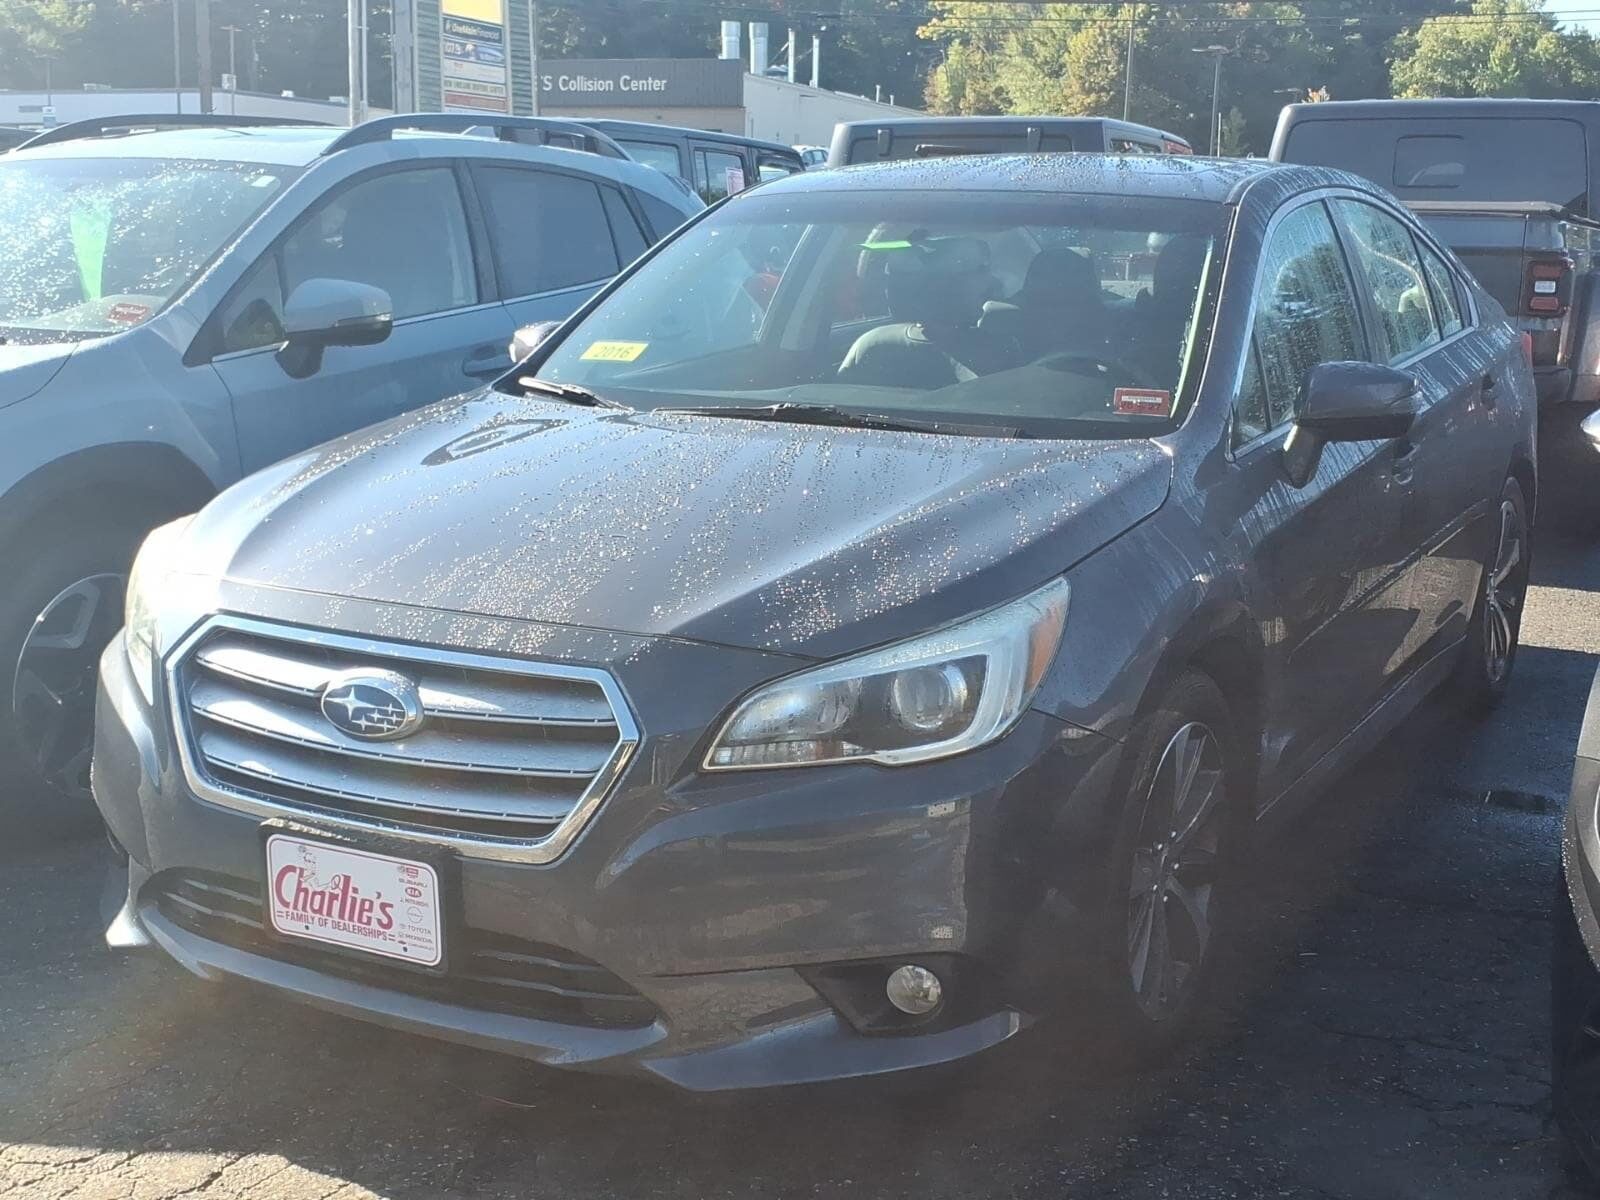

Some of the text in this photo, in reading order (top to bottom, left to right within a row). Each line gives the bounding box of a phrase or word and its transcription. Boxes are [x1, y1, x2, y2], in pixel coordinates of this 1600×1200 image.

[558, 75, 614, 92] Collision
[620, 75, 667, 91] Center
[592, 346, 635, 358] 2016
[275, 864, 394, 930] Charlie's
[285, 911, 388, 942] FAMILY OF DEALERSHIPS
[408, 924, 432, 935] TOYOTA
